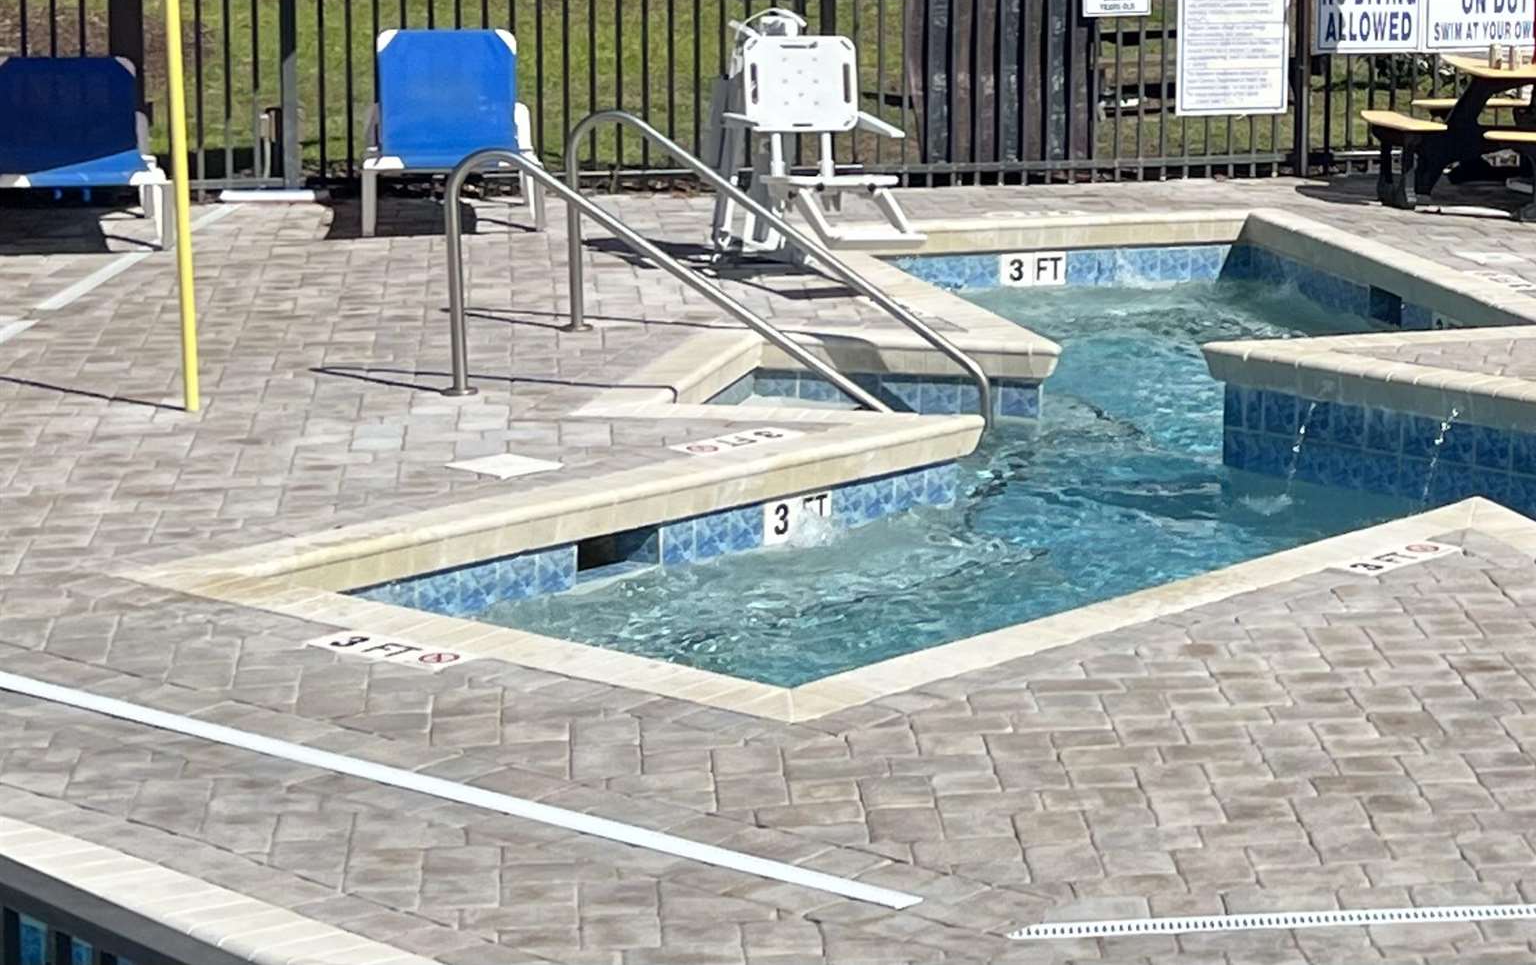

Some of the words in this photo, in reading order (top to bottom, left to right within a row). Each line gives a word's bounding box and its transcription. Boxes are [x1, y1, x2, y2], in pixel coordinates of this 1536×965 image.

[1325, 11, 1413, 42] ALLOWED
[1434, 21, 1463, 41] SWIM
[1466, 21, 1479, 40] AT
[1482, 20, 1512, 40] YOUR
[1514, 20, 1535, 40] OW
[1009, 258, 1024, 282] 3
[1036, 256, 1063, 281] FT
[774, 503, 789, 535] 3
[330, 636, 371, 647] 3
[361, 642, 424, 657] FT
